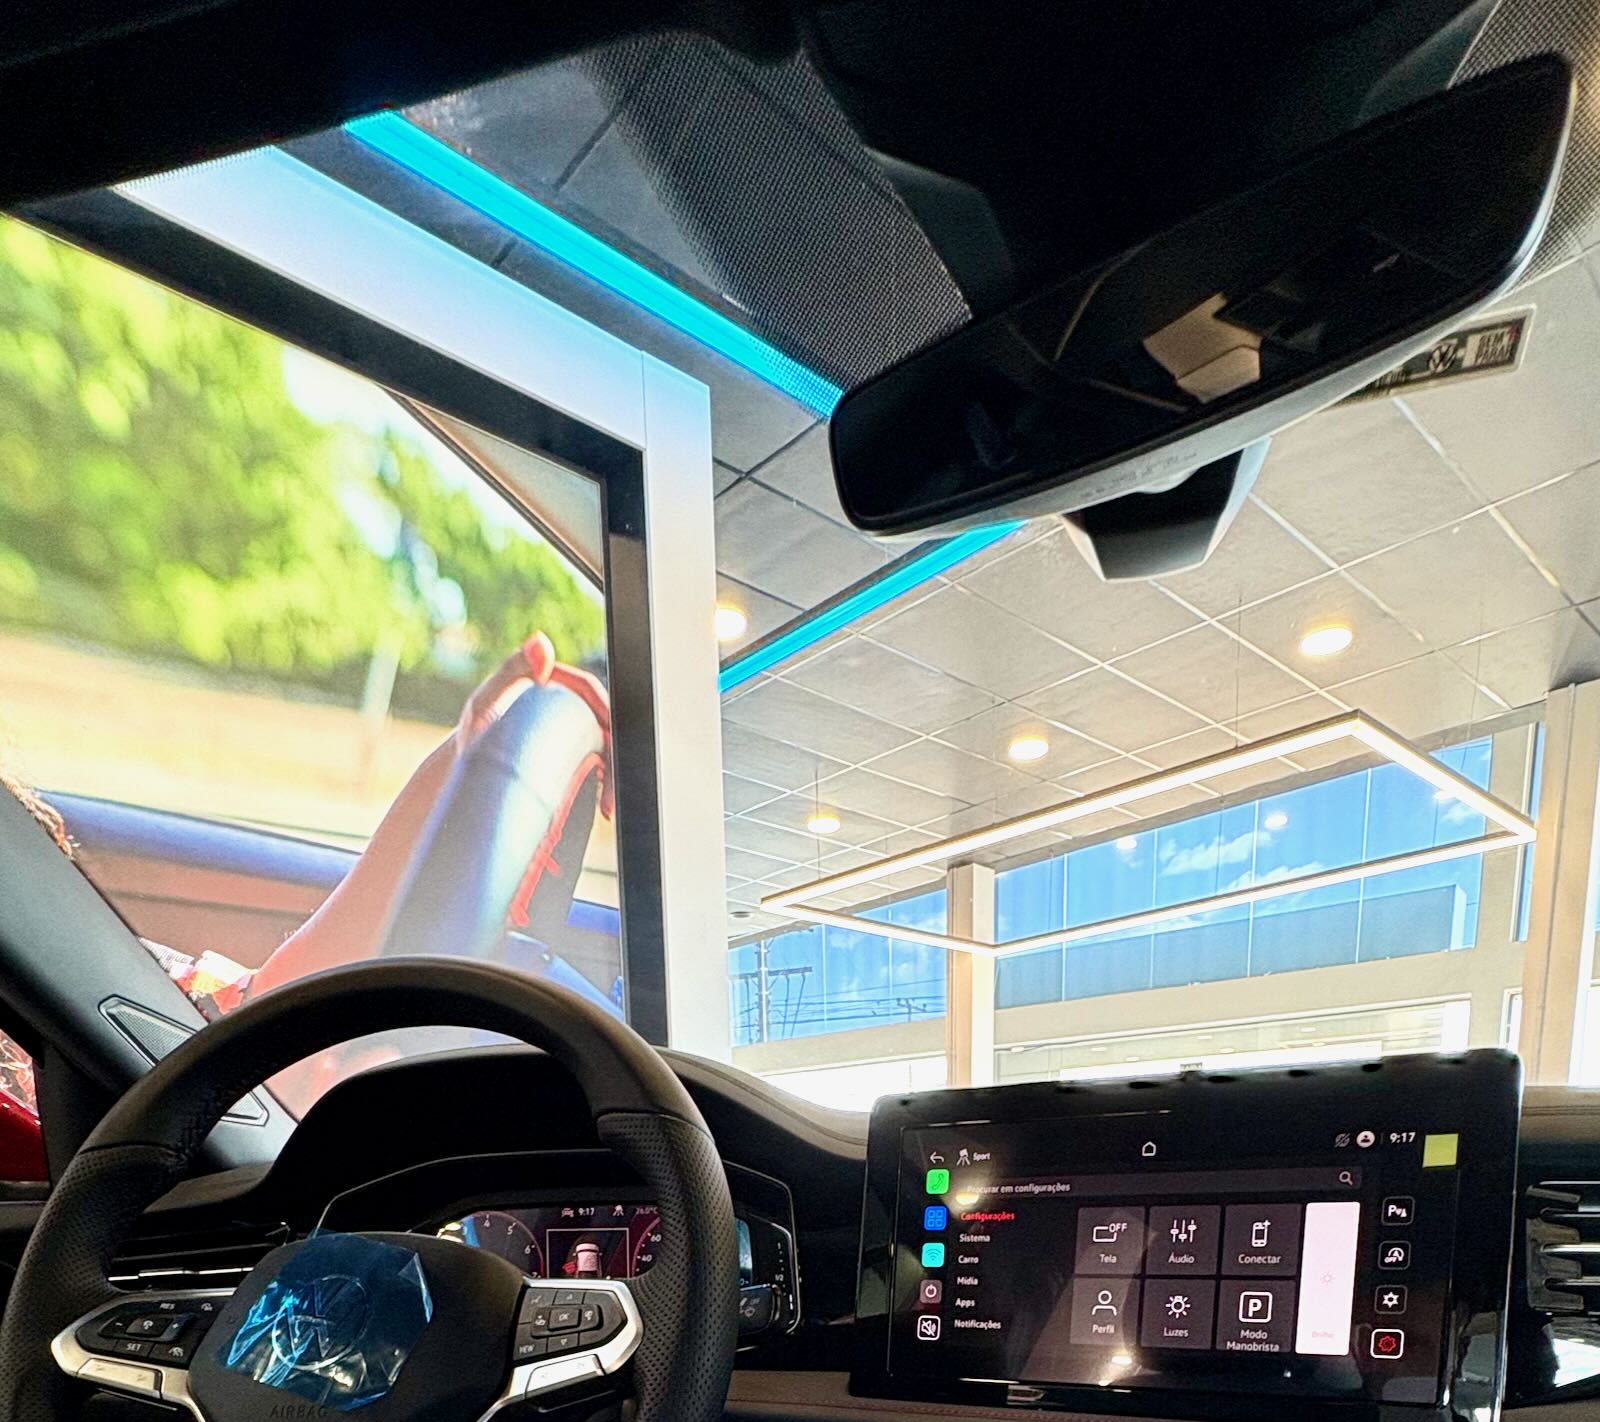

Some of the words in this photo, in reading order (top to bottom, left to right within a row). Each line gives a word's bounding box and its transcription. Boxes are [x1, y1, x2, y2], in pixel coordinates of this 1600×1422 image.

[1389, 1132, 1416, 1143] 9:17
[973, 1152, 991, 1161] Sport
[967, 1185, 999, 1194] Procurar
[1015, 1182, 1071, 1194] configurações
[578, 1207, 595, 1217] 9:17
[960, 1211, 1015, 1222] Configurações
[1109, 1222, 1128, 1233] OFF
[650, 1234, 662, 1243] 60
[960, 1233, 991, 1243] Sistema
[958, 1255, 979, 1264] Carro
[1099, 1253, 1117, 1263] Tela
[1168, 1252, 1195, 1264] Áudio
[1238, 1253, 1281, 1264] Conectar
[955, 1297, 976, 1308] Apps
[954, 1319, 1002, 1330] Notificações
[1092, 1323, 1115, 1334] Perfil
[1163, 1327, 1189, 1337] Luzes
[1240, 1329, 1268, 1339] Modo
[126, 1343, 142, 1352] SET
[1226, 1341, 1280, 1352] Manobrista
[270, 1403, 329, 1420] AIRBAG
